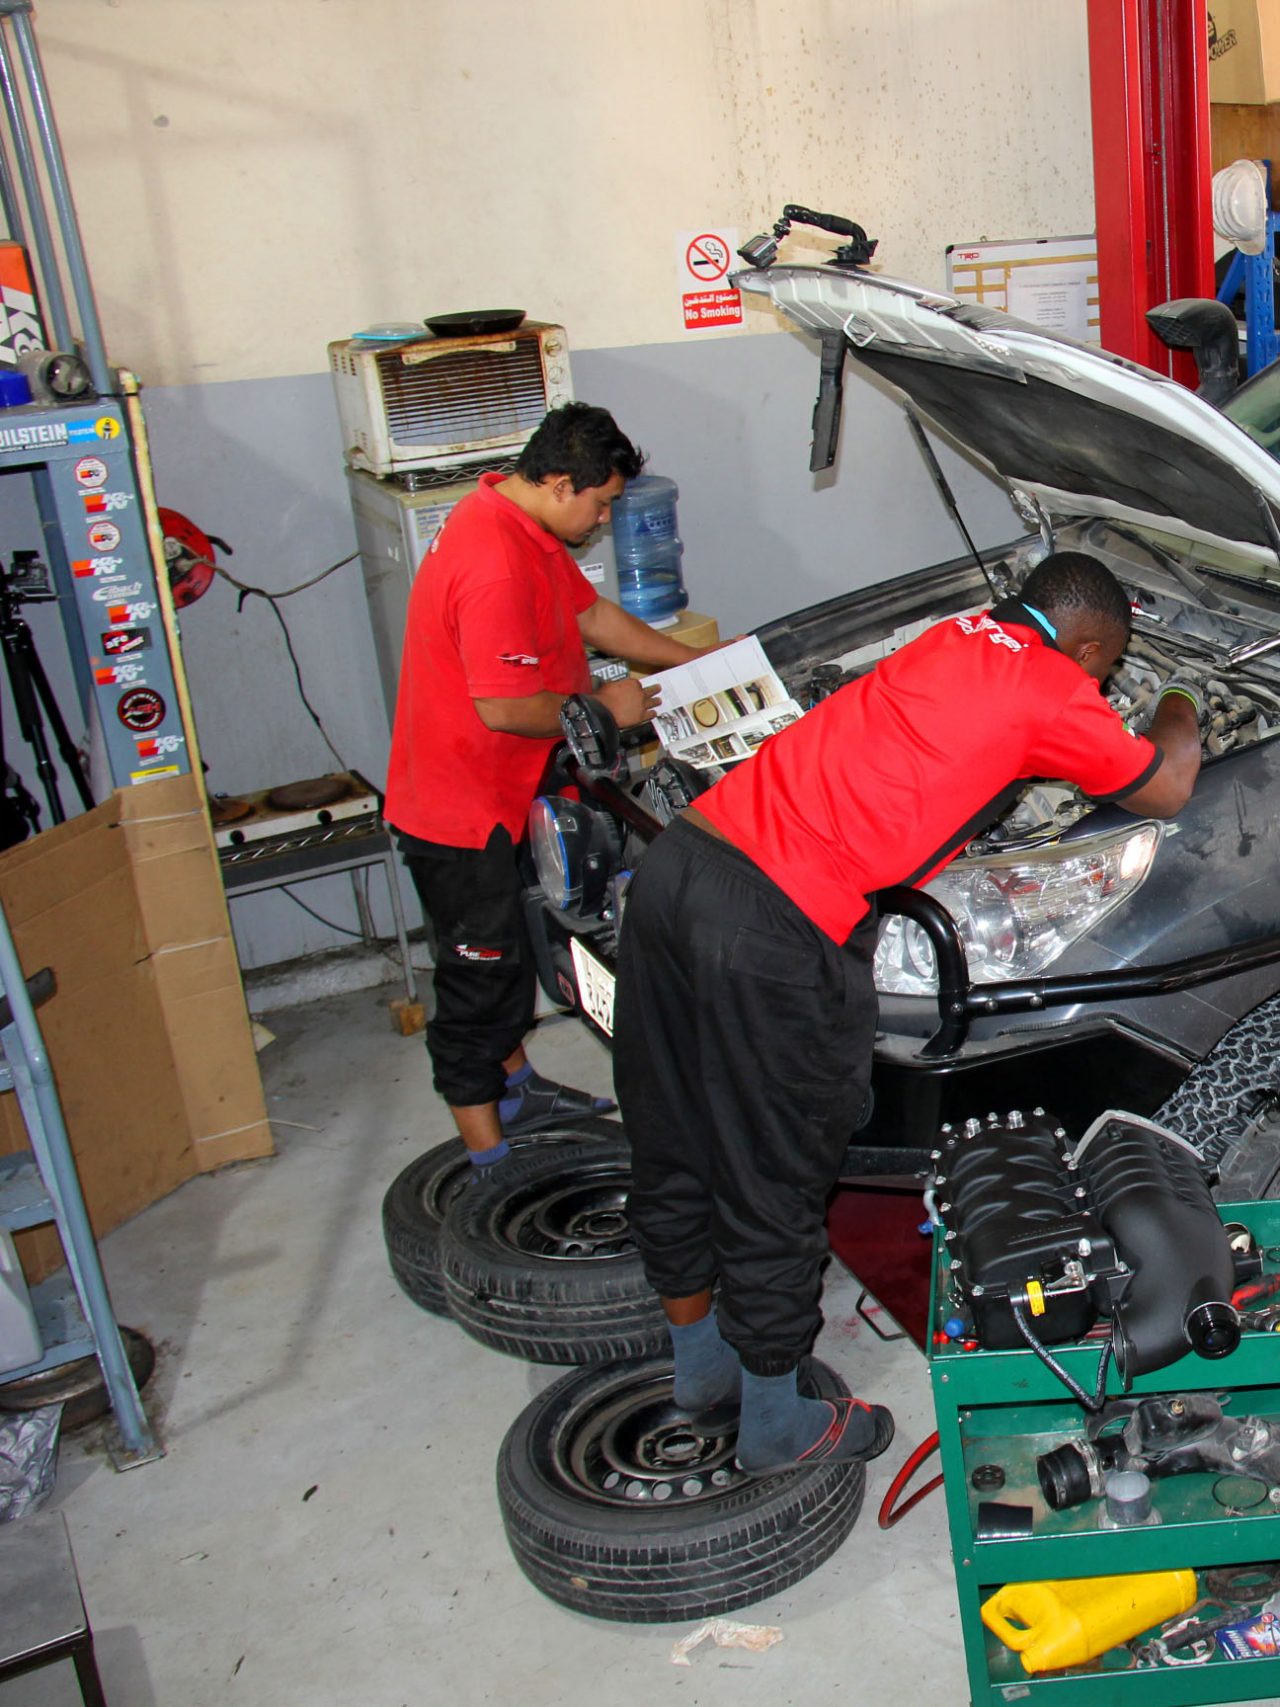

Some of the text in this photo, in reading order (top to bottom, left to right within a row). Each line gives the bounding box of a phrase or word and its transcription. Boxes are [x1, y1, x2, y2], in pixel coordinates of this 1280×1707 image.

[957, 252, 980, 261] TRD
[685, 304, 741, 320] No Smoking
